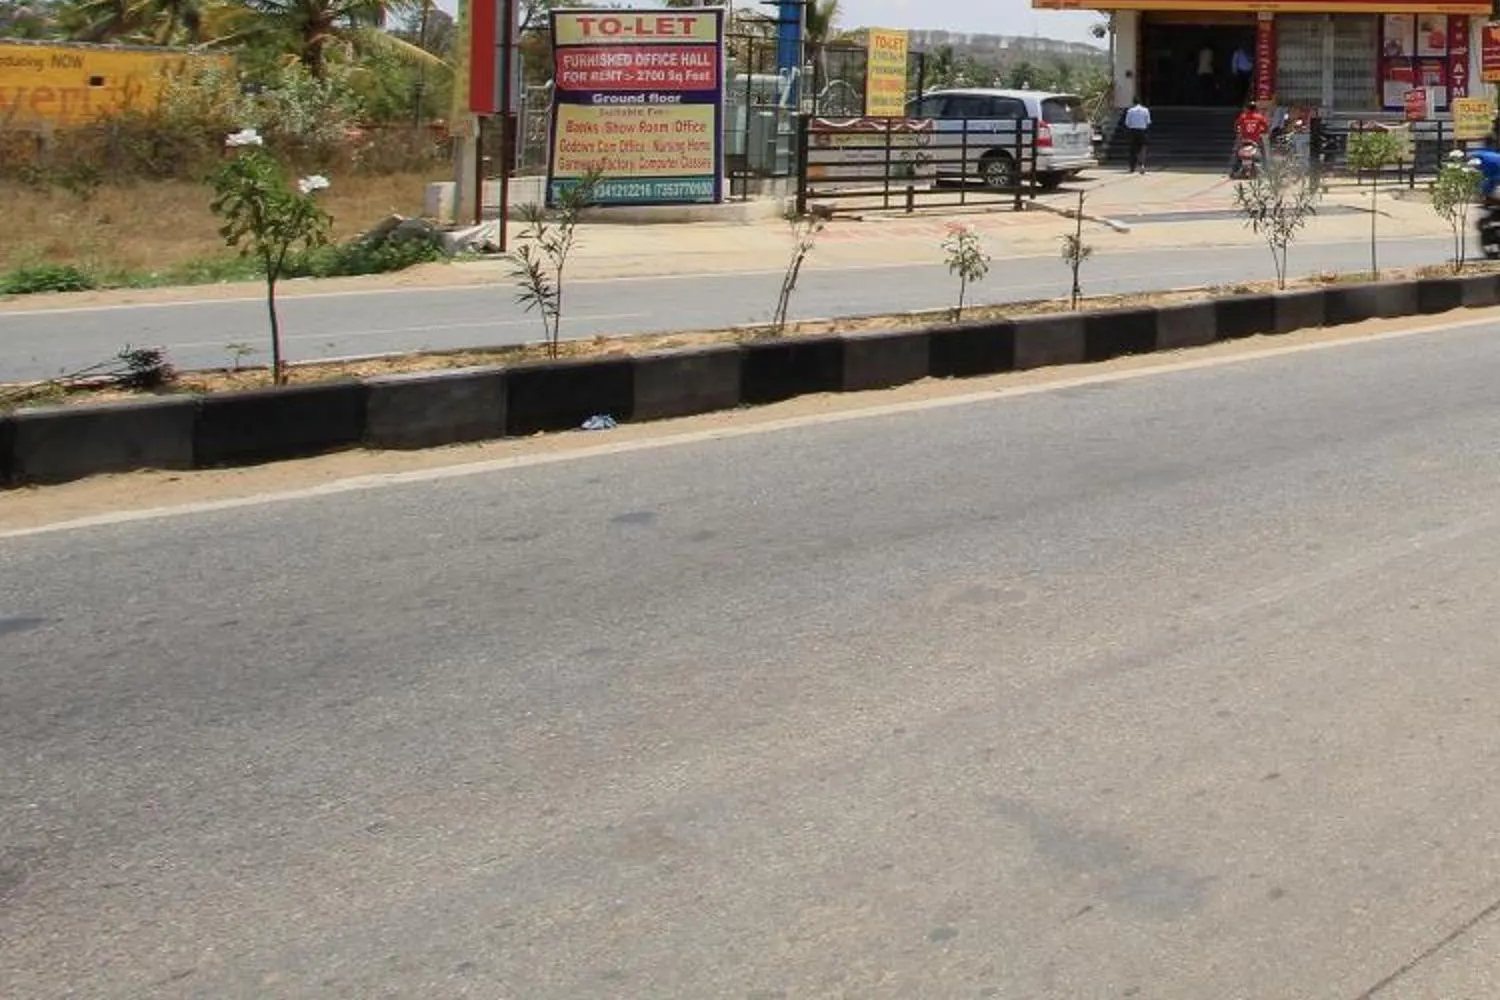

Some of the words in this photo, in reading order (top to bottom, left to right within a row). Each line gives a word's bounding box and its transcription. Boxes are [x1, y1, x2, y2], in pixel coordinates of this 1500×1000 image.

[576, 17, 698, 36] TO-LET
[563, 52, 632, 68] FURNISHED
[635, 52, 679, 67] OFFICE
[681, 52, 711, 66] HALL
[563, 71, 588, 82] FOR
[590, 70, 622, 81] RENT
[637, 70, 665, 81] 2700
[592, 93, 645, 103] Ground
[648, 93, 682, 103] floor
